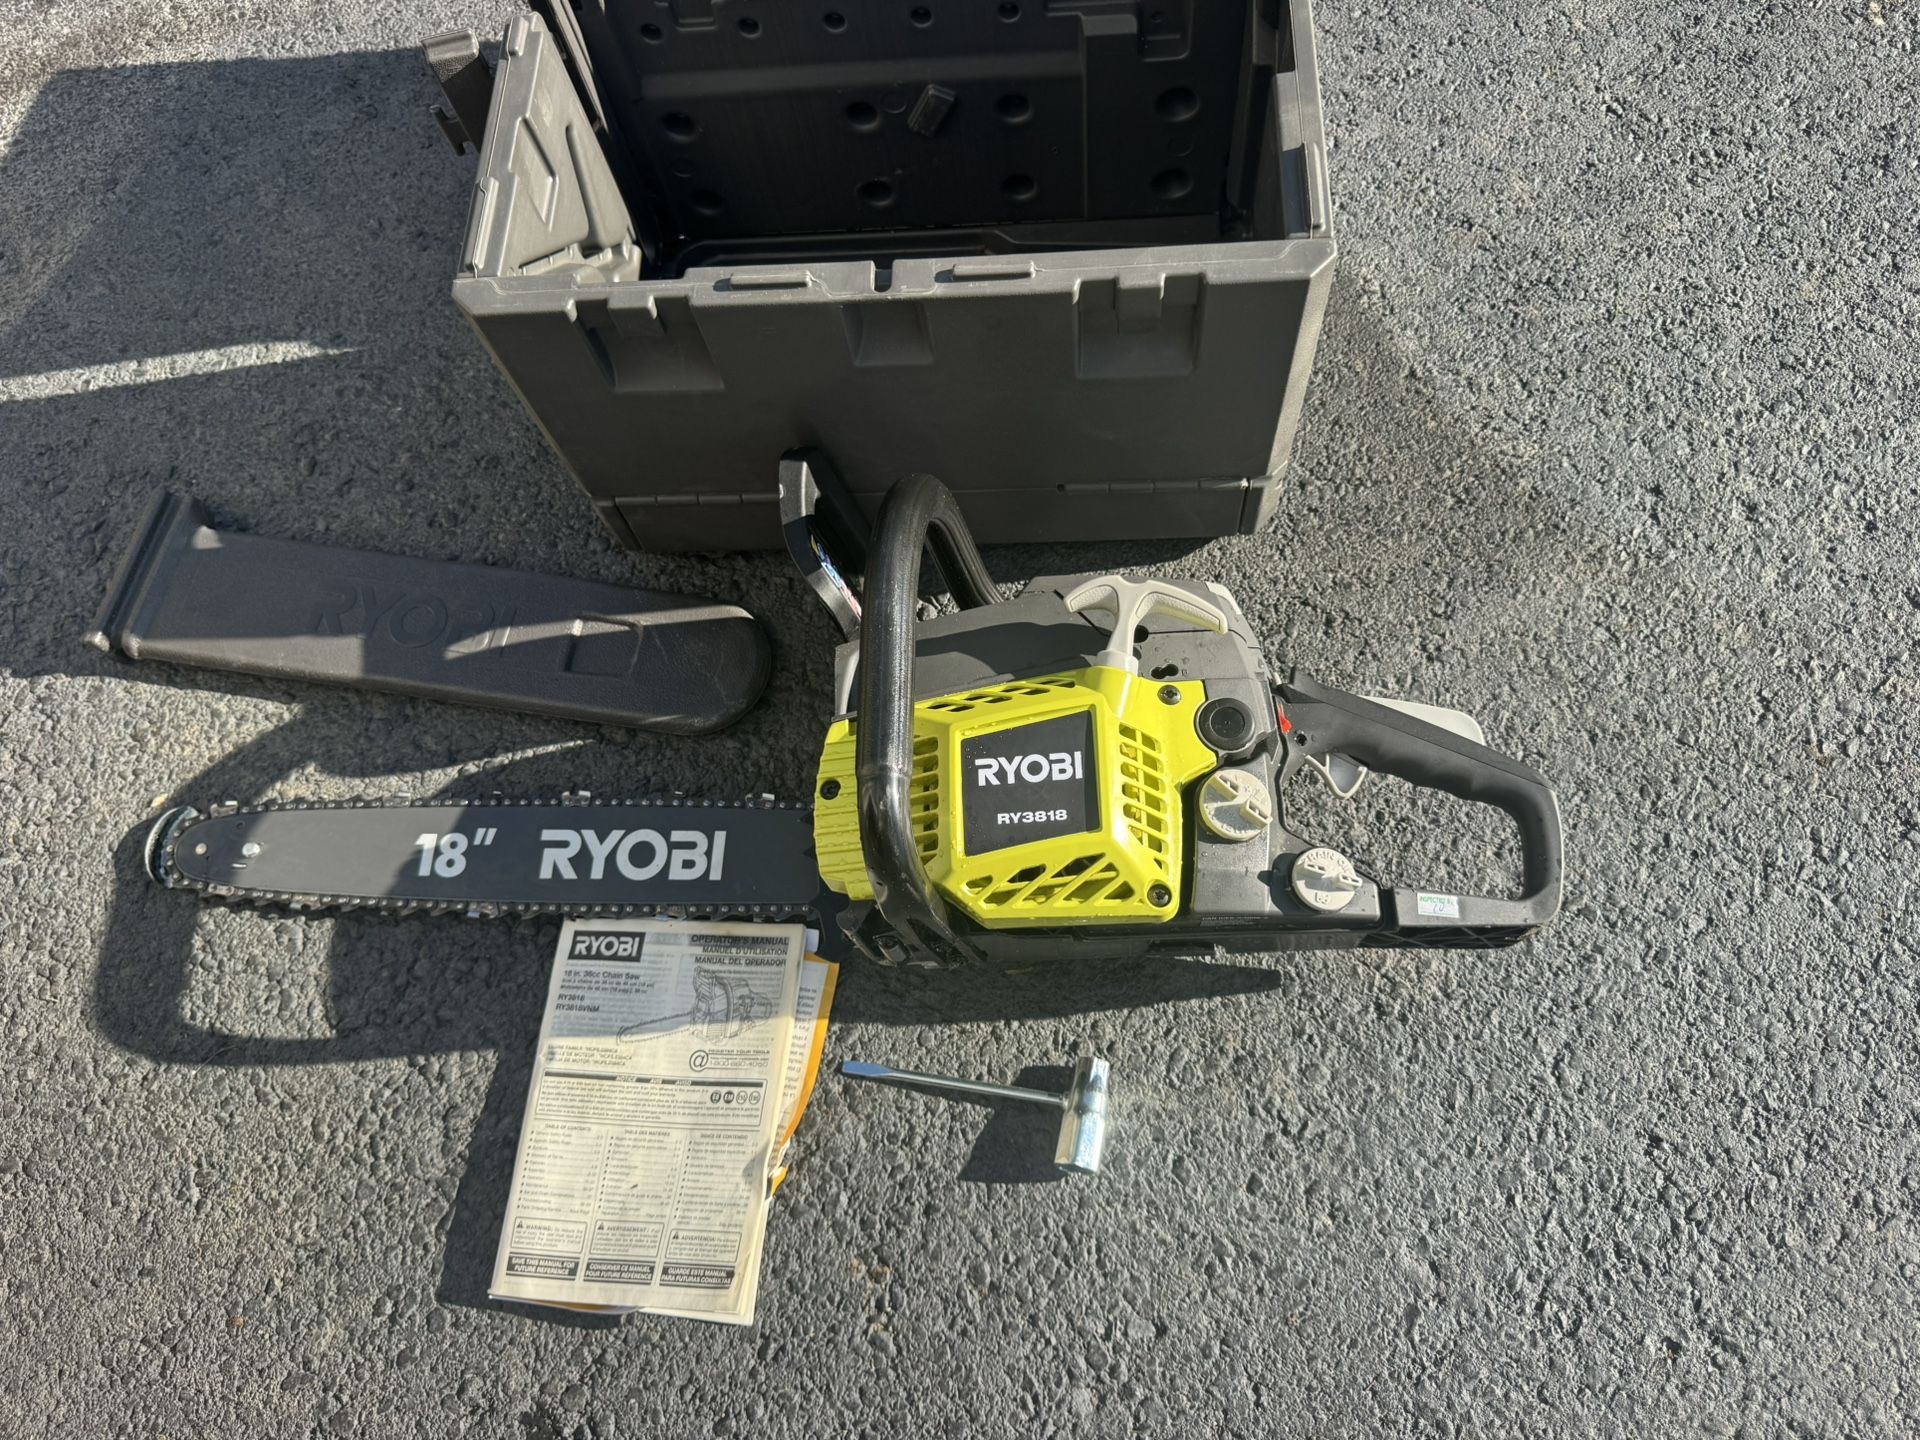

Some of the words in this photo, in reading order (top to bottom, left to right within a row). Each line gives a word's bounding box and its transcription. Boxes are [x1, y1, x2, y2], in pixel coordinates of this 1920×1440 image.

[314, 585, 518, 658] RYOBI
[975, 751, 1083, 786] RYOBI
[997, 809, 1068, 825] RY3818
[414, 828, 497, 878] 18"
[539, 829, 726, 881] RYOBI
[574, 936, 641, 957] RYOBI
[691, 934, 750, 945] OPERATOR'S
[751, 936, 789, 946] MANUAL
[702, 945, 735, 954] MANUEL
[735, 946, 787, 956] D'UTILISATION
[694, 956, 727, 965] MANUAL
[728, 957, 743, 966] DEL
[744, 958, 786, 967] OPERADOR
[602, 971, 623, 979] Chain
[625, 972, 640, 980] Saw
